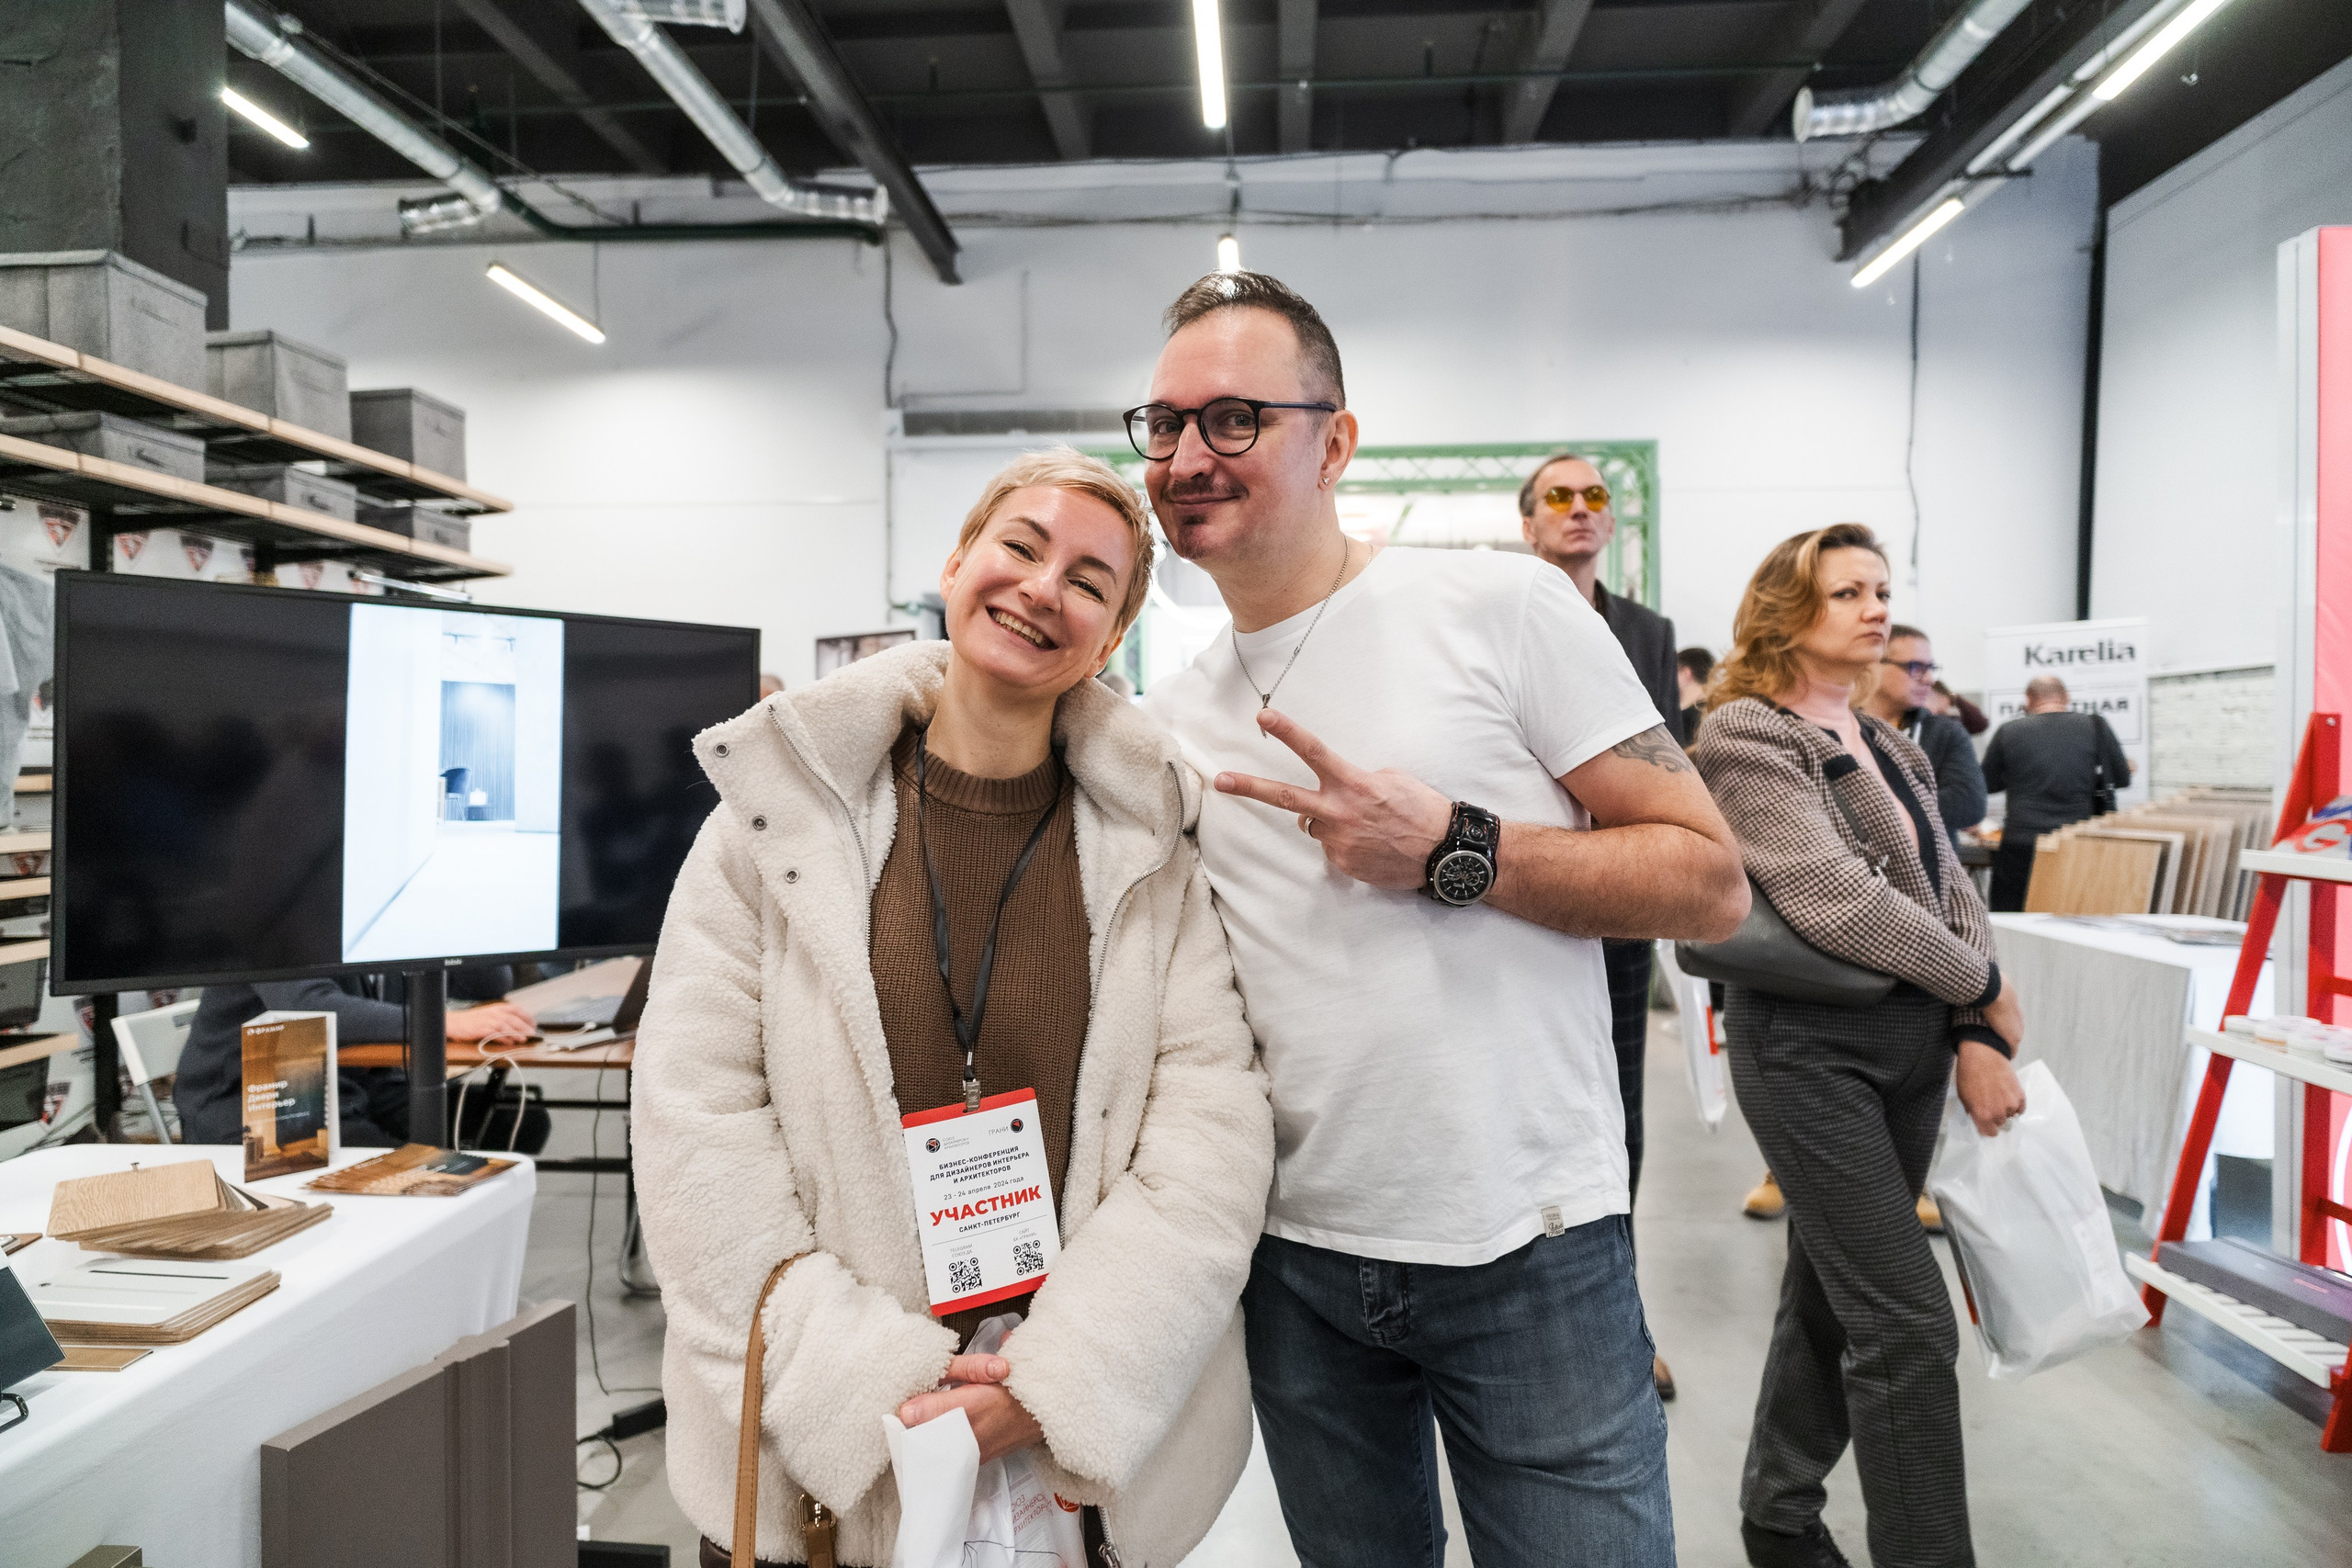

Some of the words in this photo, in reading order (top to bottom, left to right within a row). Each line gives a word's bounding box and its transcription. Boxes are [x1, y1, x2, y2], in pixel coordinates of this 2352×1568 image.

[2024, 638, 2135, 667] Karelia
[1999, 699, 2129, 715] ПАТНАЯ
[247, 1080, 288, 1093] Фрамир
[247, 1091, 279, 1104] Двери
[248, 1098, 296, 1112] Интерьер
[988, 1126, 1010, 1136] ГРАНИ
[939, 1145, 1019, 1170] БИЗНЕС-КОНФЕРЕНЦИЯ
[930, 1172, 944, 1182] ДЛЯ
[945, 1161, 992, 1178] ДИЗАЙНЕРОВ
[992, 1151, 1030, 1168] ИНТЕРЬЕРА
[959, 1165, 1012, 1183] АРХИТЕКТОРОВ
[967, 1185, 991, 1196] апреля
[993, 1179, 1009, 1189] 2024
[1010, 1176, 1024, 1185] года
[930, 1185, 1042, 1226] УЧАСТНИК
[958, 1211, 1021, 1233] САНКТ-ПЕТЕРБУРГ
[950, 1244, 973, 1253] TELEGRAM
[951, 1250, 966, 1258] СОЮЗ
